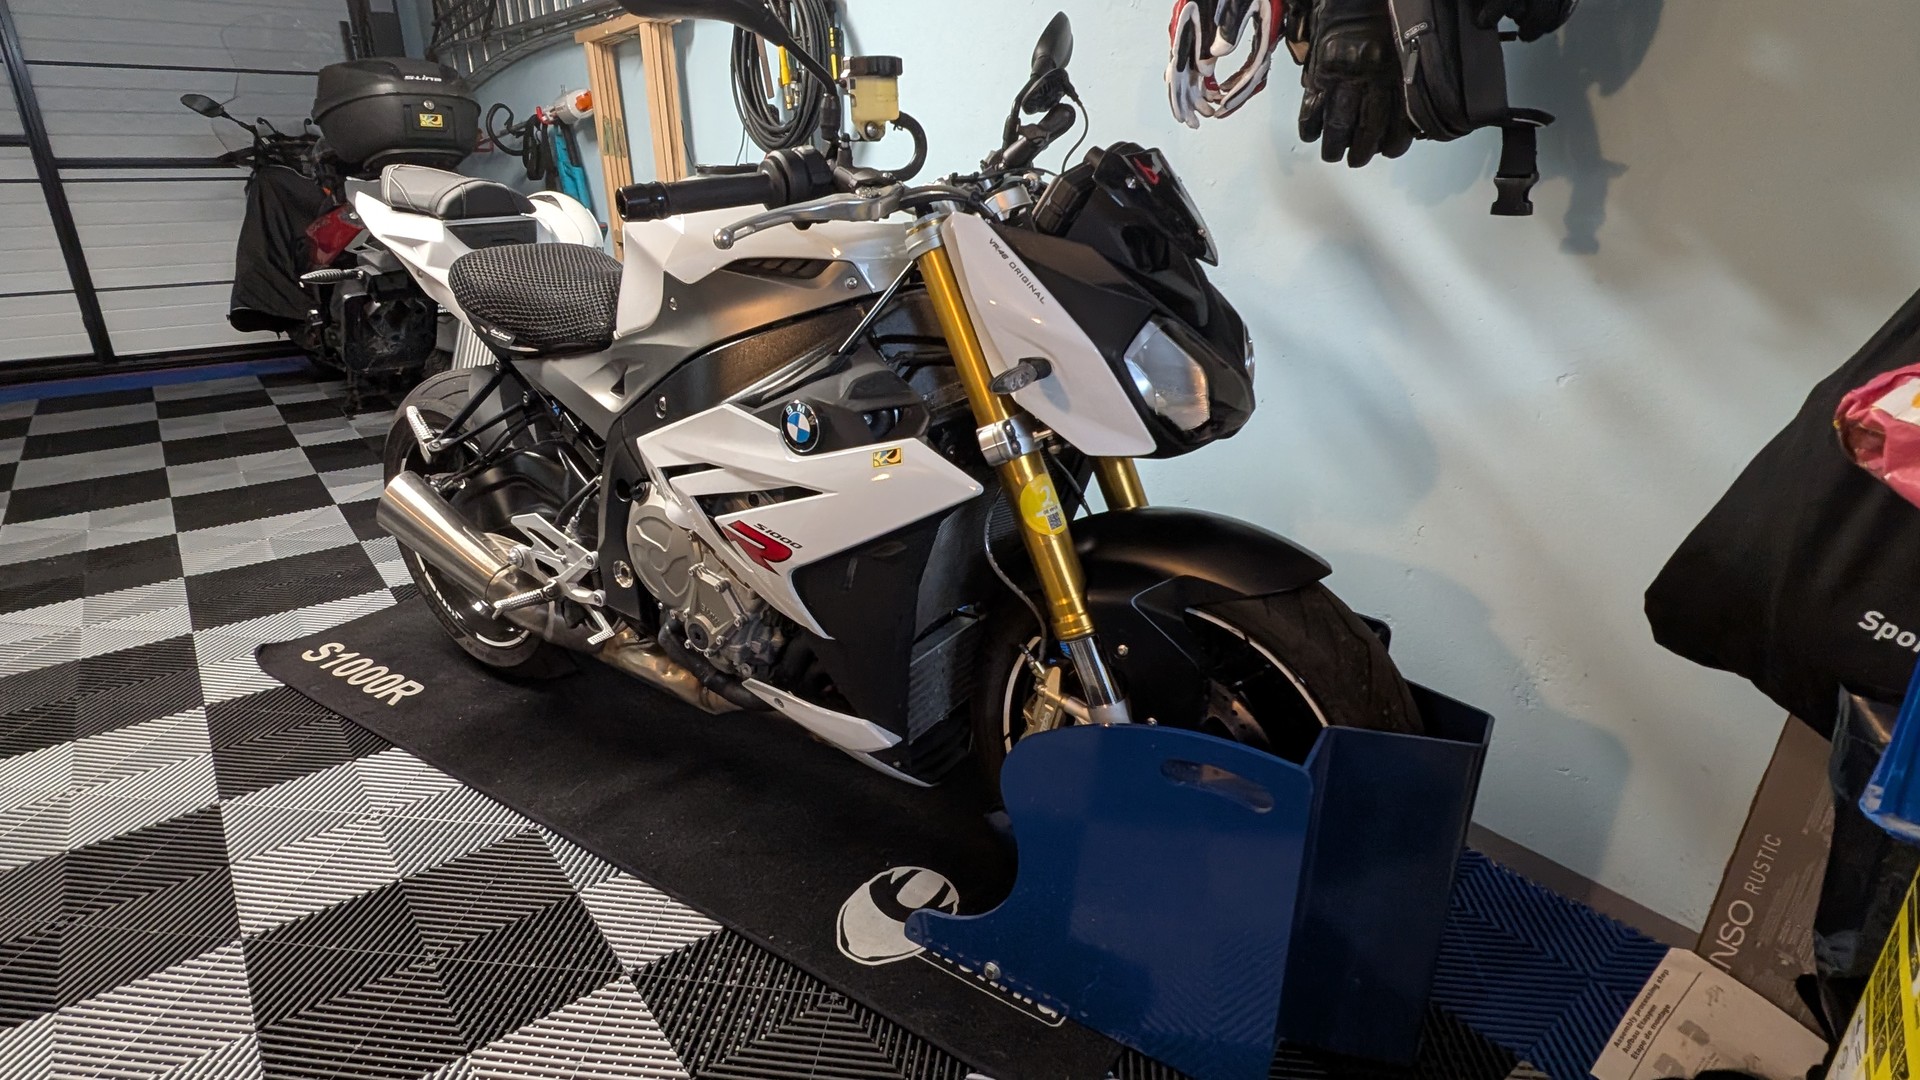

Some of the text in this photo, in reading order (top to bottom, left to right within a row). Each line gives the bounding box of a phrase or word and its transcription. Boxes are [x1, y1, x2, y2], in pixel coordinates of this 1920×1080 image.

[1009, 261, 1045, 305] ORIGINAL
[786, 403, 816, 426] BMW
[753, 523, 803, 549] S1000
[301, 642, 425, 706] S1000R
[1744, 833, 1782, 895] RUSTIC
[1709, 900, 1754, 970] NSO
[1613, 969, 1670, 1048] Assembly processing step
[1630, 1040, 1647, 1060] Etape
[1650, 1004, 1672, 1030] montage
